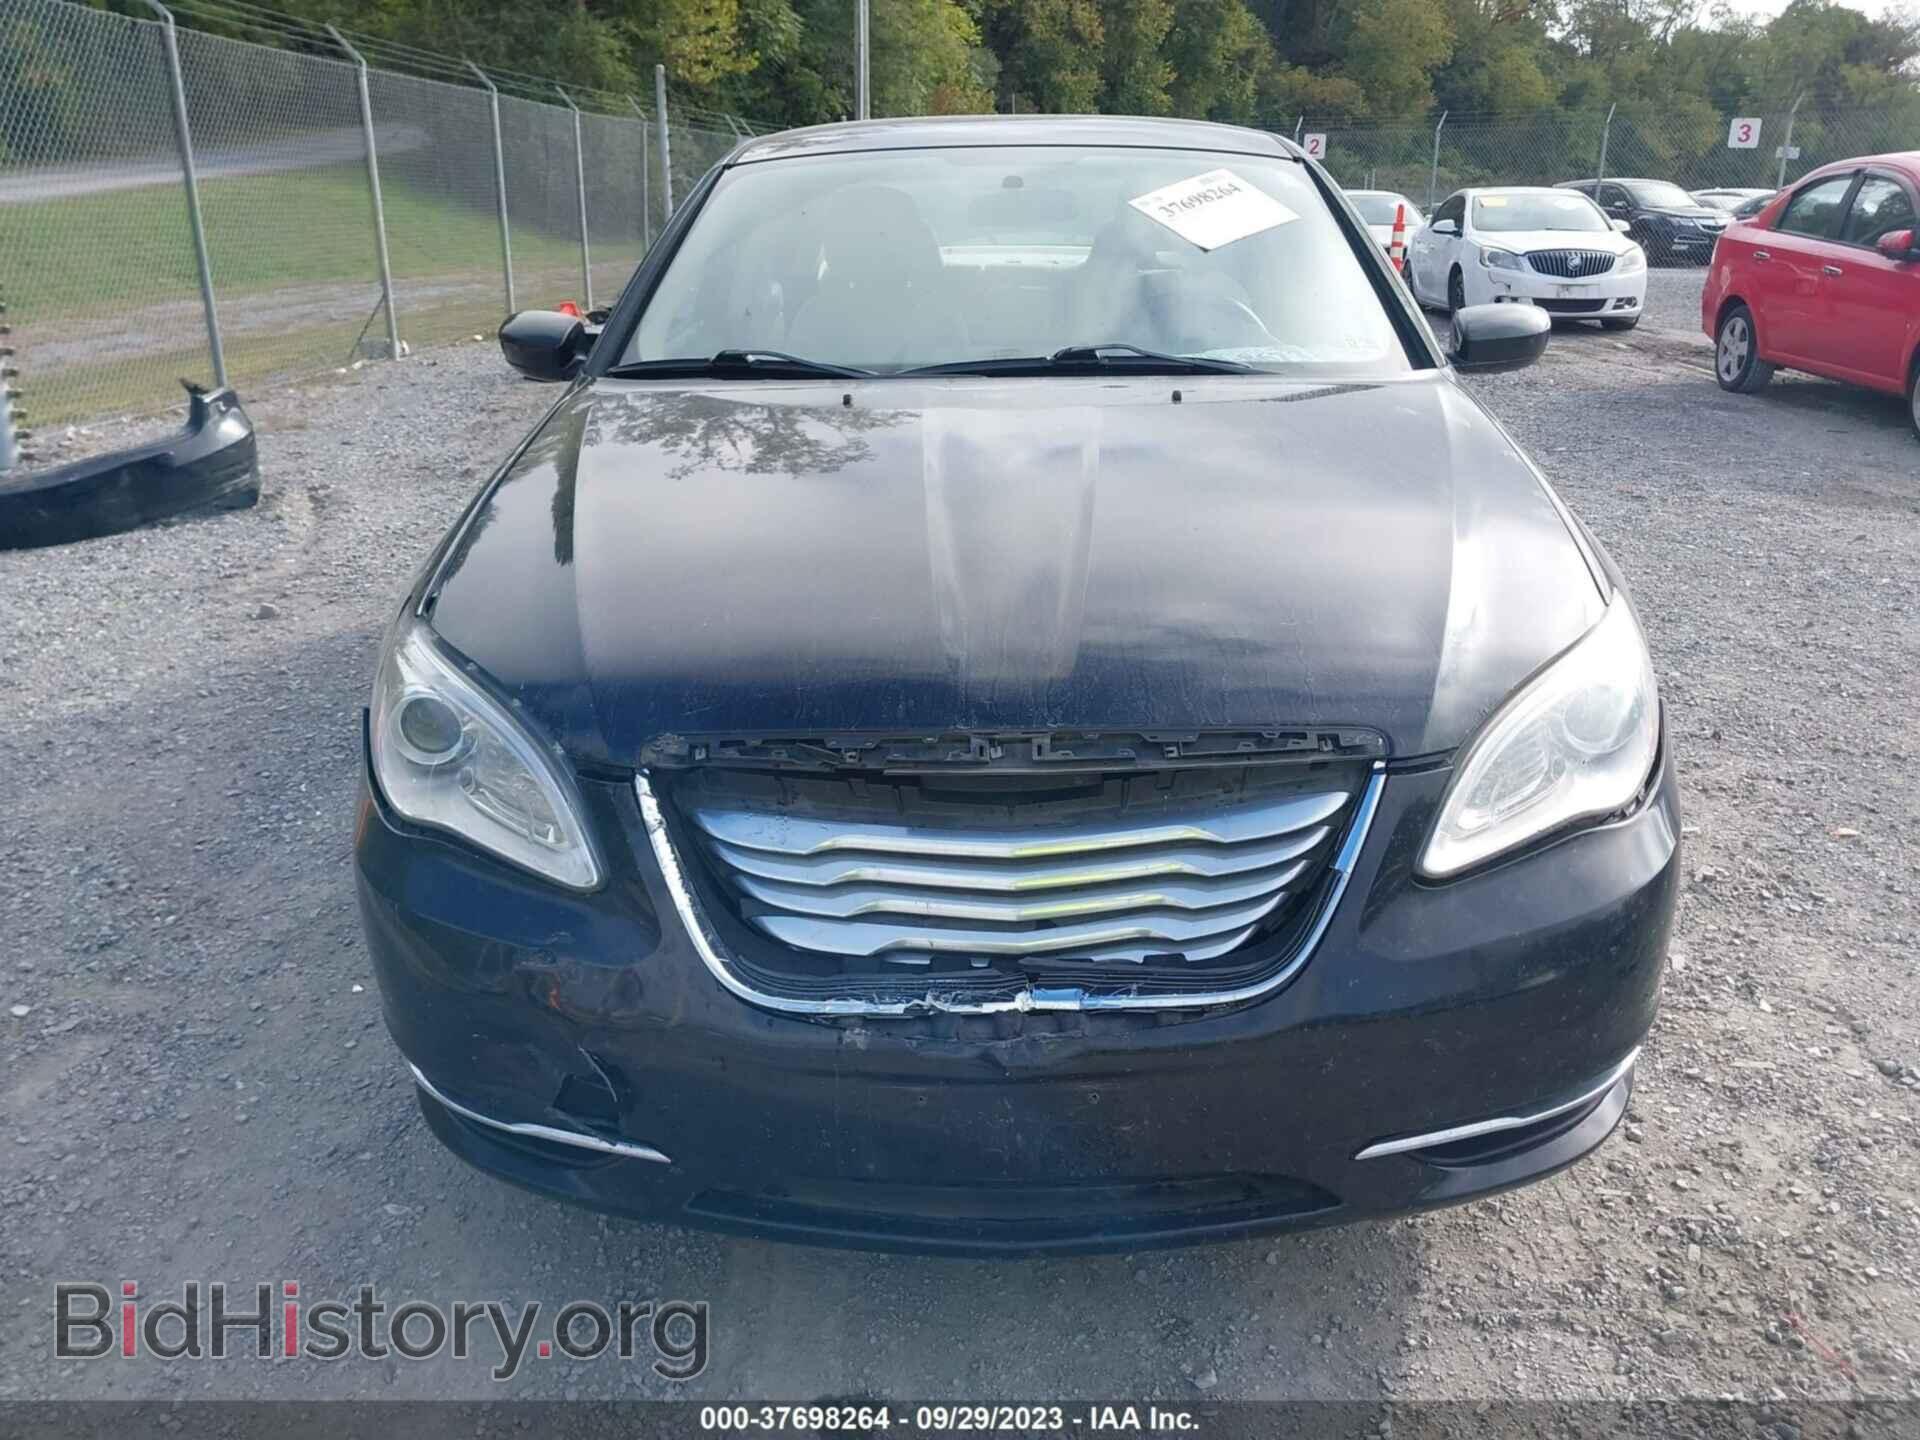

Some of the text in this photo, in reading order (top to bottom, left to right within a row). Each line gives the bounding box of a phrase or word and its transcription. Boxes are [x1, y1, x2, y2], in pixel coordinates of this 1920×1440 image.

[1737, 123, 1752, 143] 3
[1309, 138, 1320, 155] 2
[1158, 183, 1242, 217] 37698264
